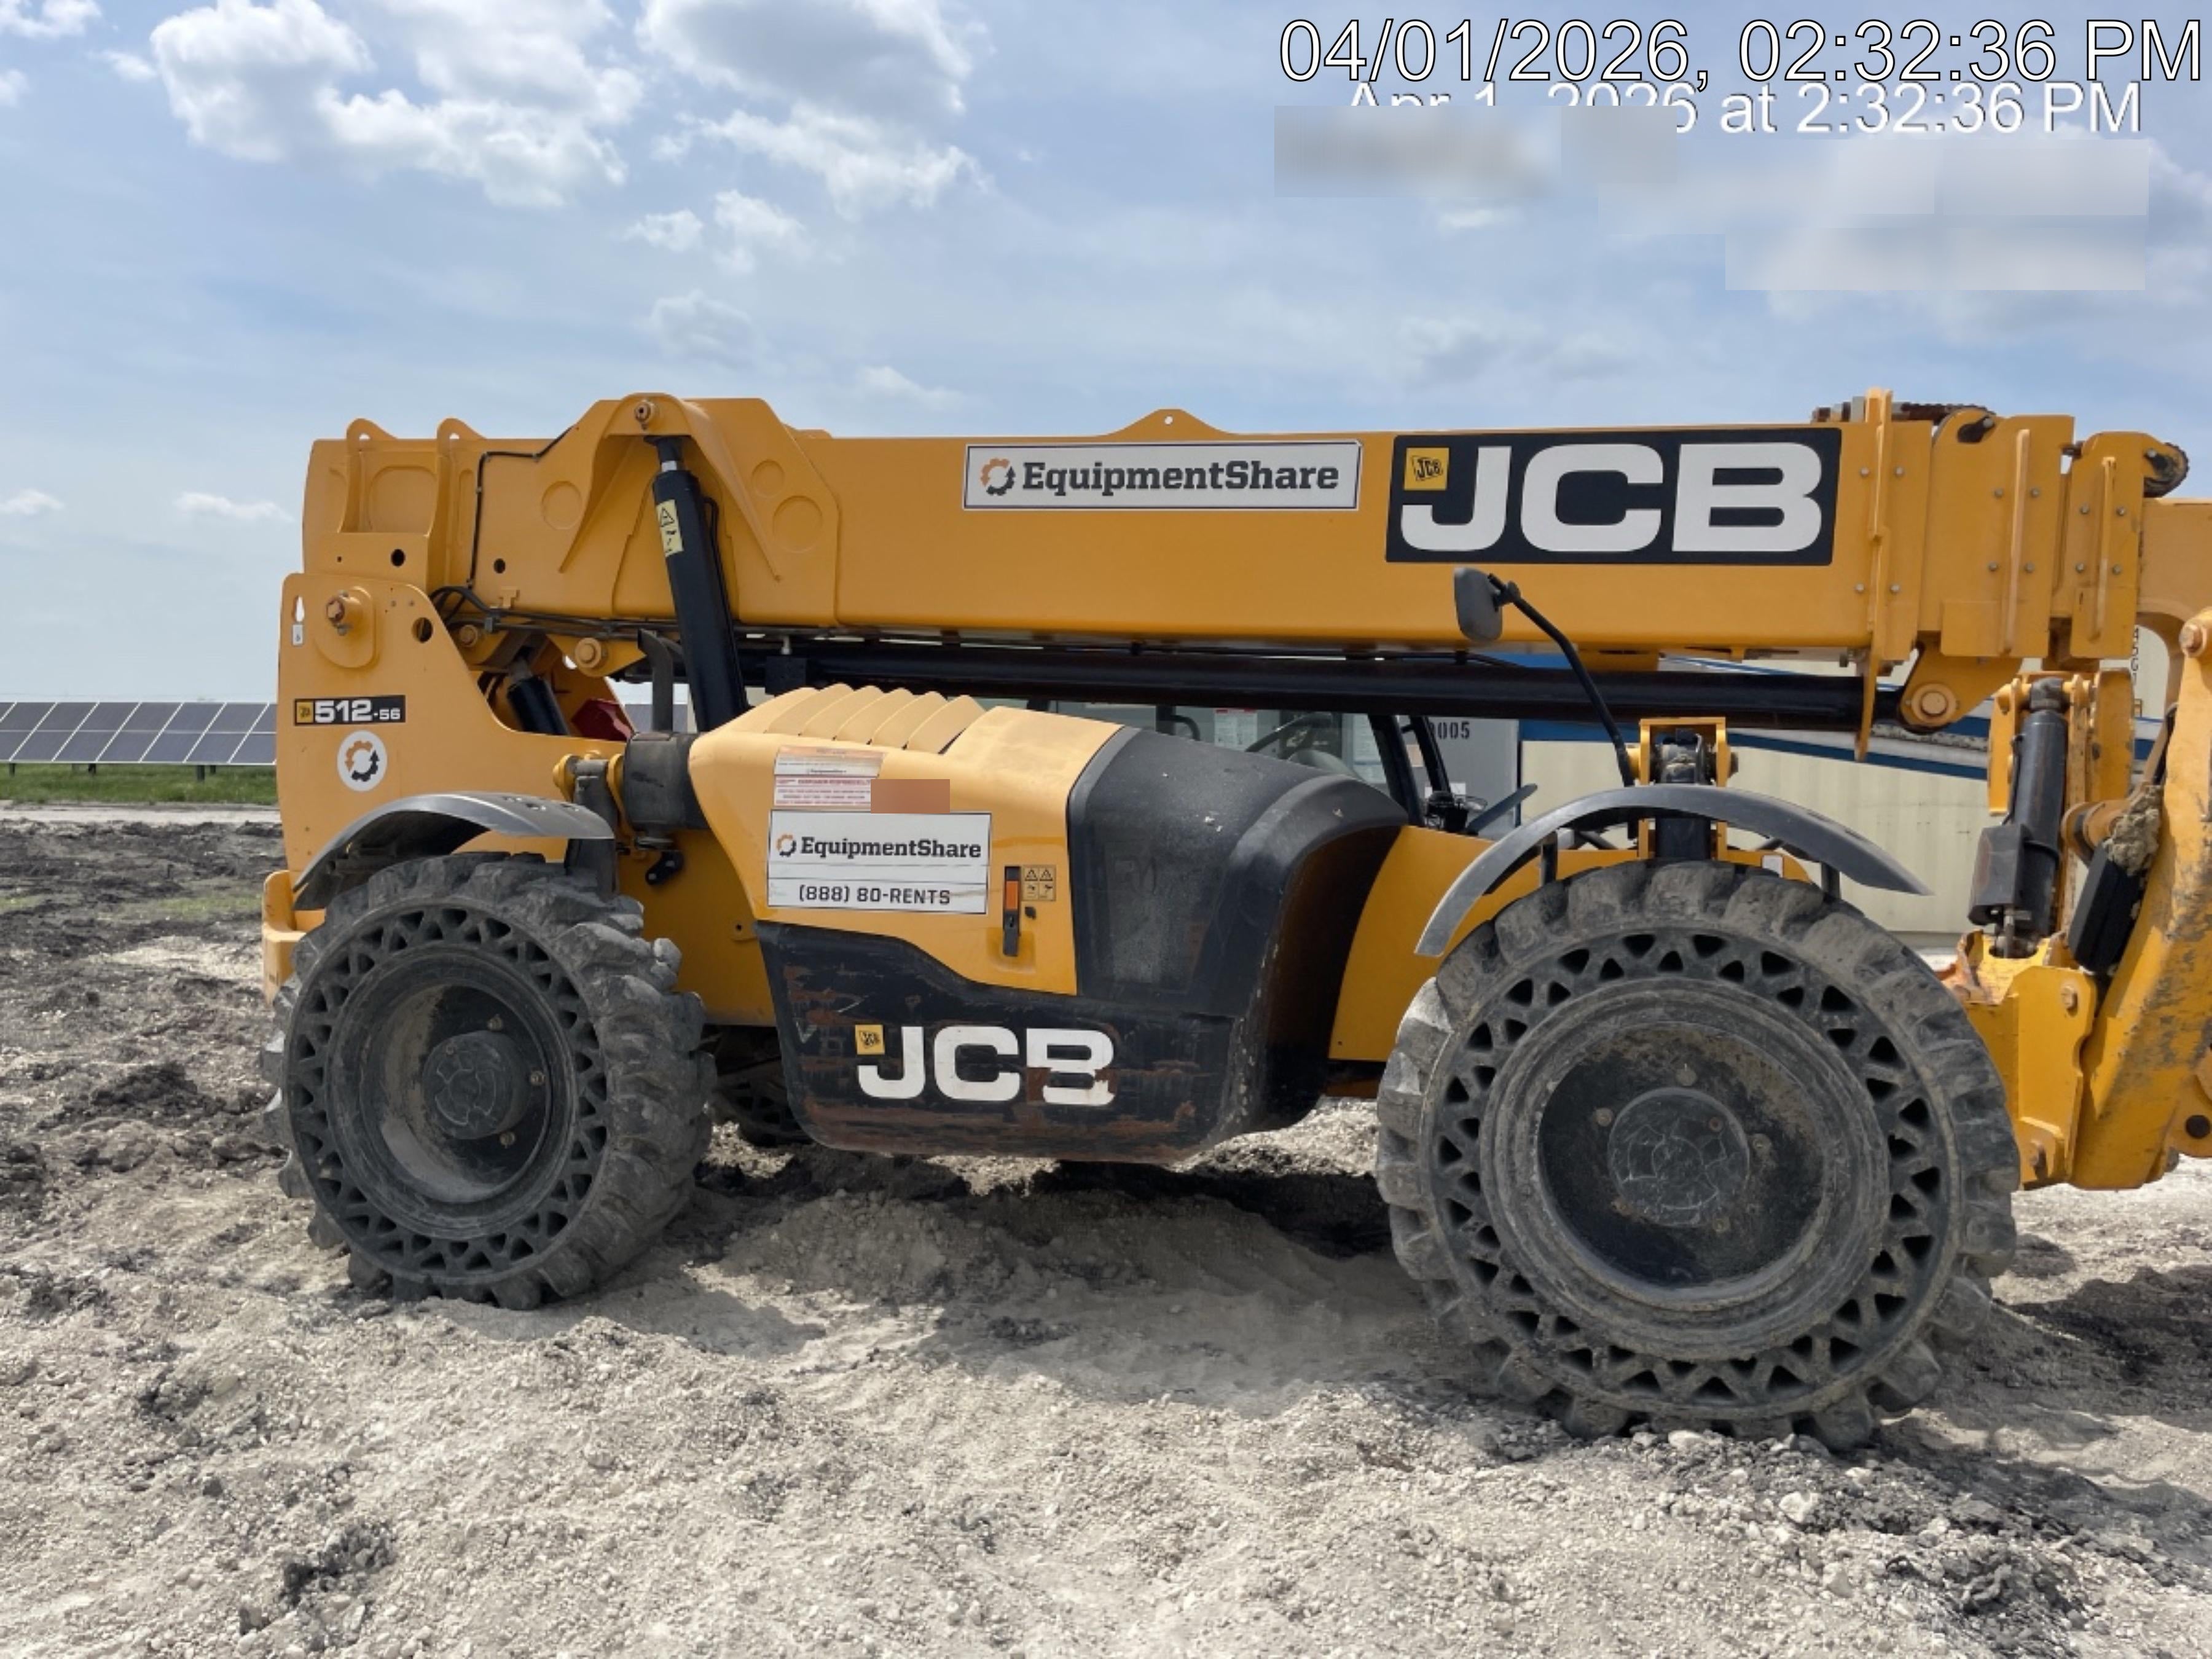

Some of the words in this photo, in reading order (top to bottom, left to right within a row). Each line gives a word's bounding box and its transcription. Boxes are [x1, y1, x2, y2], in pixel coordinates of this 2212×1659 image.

[1022, 459, 1339, 495] EquipmentShare
[1400, 442, 1822, 553] JCB
[801, 836, 981, 859] EquipmentShare
[799, 884, 850, 902] (888)
[857, 887, 951, 905] 80-RENTS
[857, 1026, 1115, 1106] JCB
